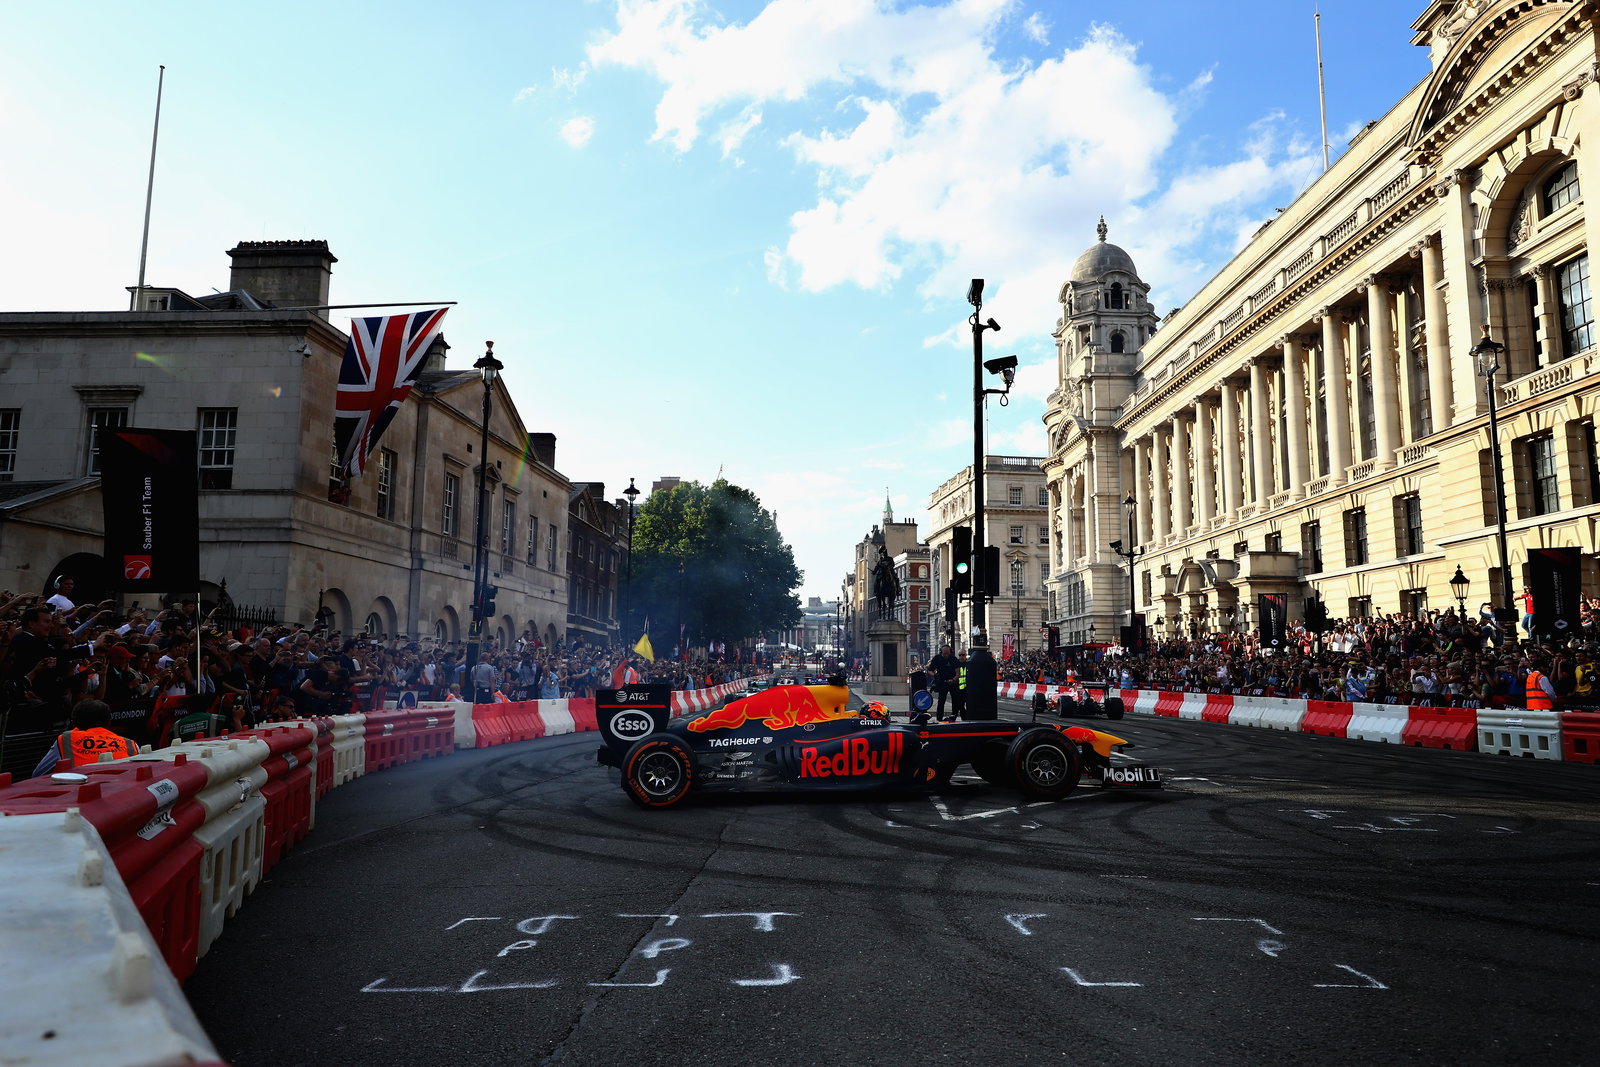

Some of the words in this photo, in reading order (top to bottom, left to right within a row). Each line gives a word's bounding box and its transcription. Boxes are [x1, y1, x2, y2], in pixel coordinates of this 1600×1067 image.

[142, 476, 152, 502] Team
[142, 503, 152, 515] F1
[142, 516, 152, 550] Sauber
[628, 692, 650, 701] AT&T
[1461, 699, 1481, 708] LIVE
[617, 717, 648, 731] Esso
[83, 739, 120, 749] 024
[1103, 767, 1144, 783] Mobil
